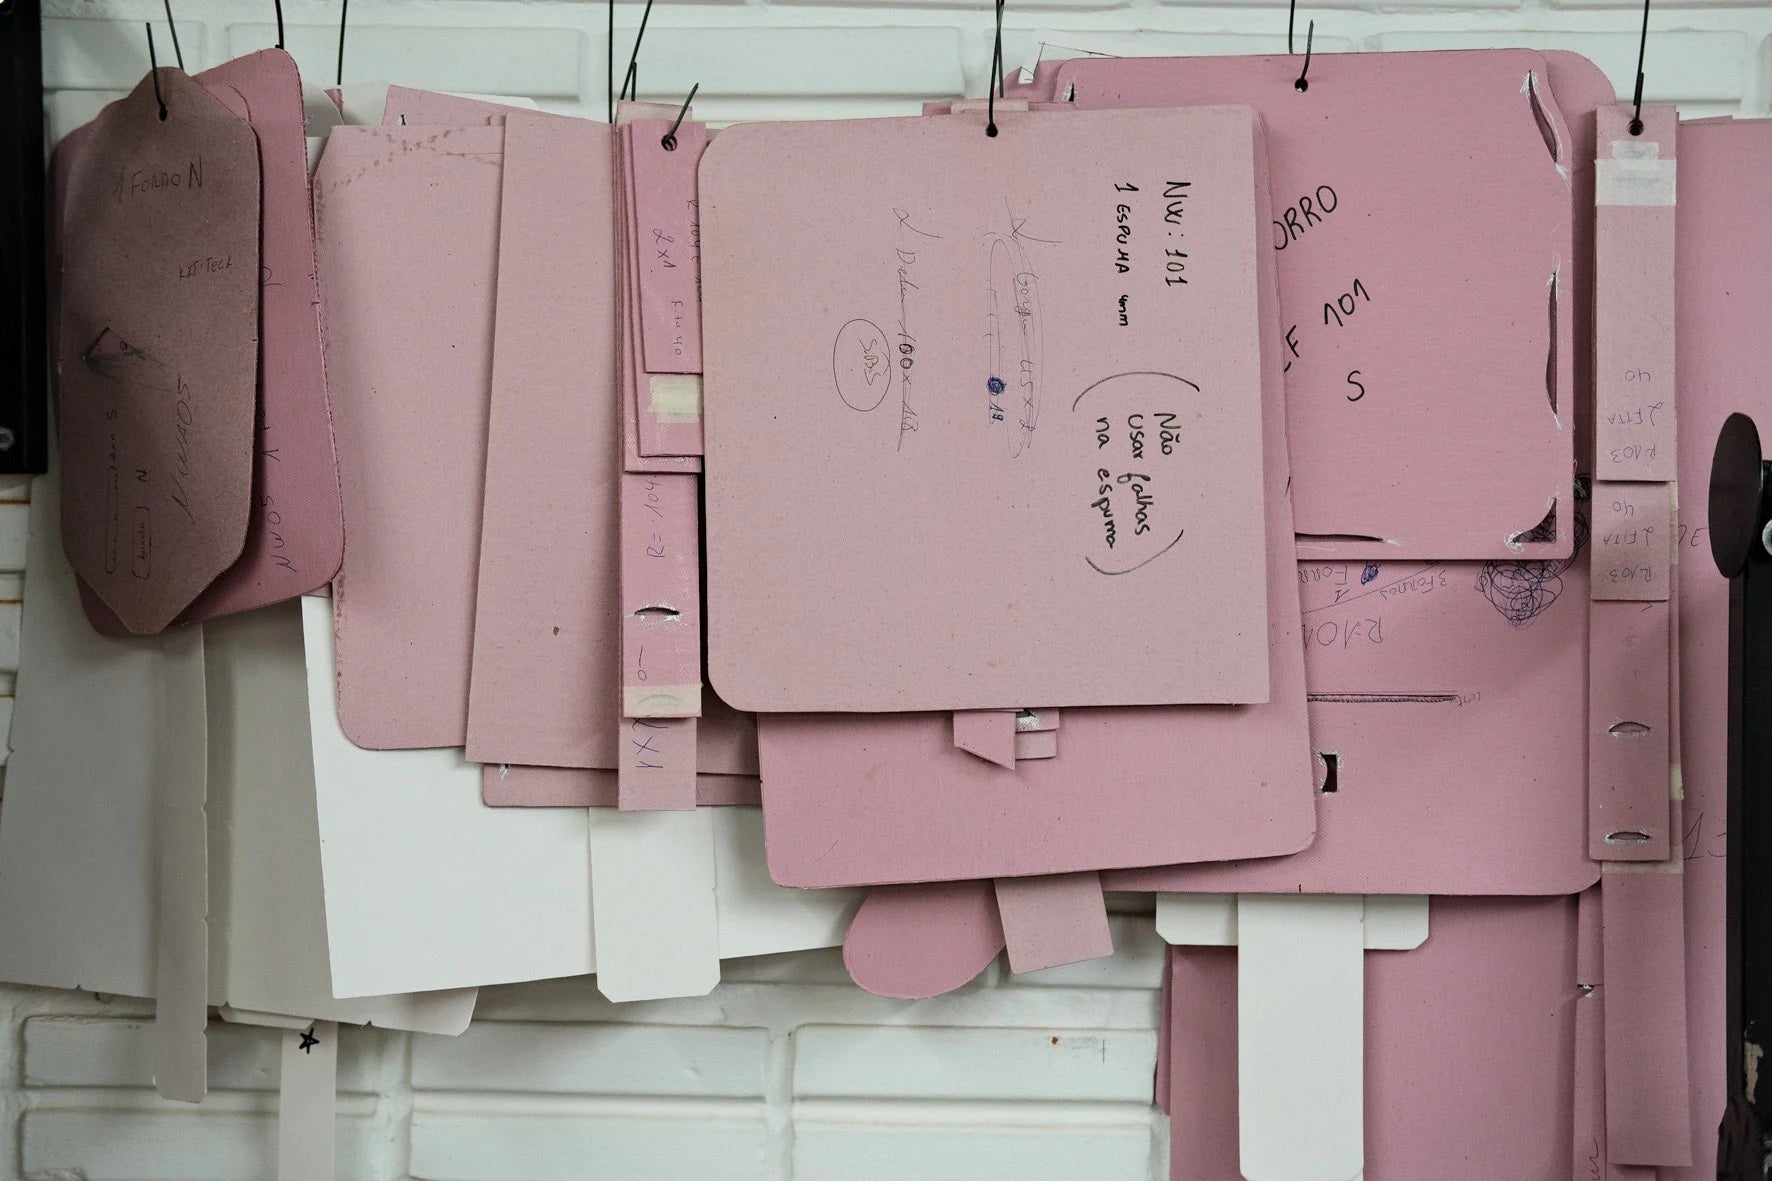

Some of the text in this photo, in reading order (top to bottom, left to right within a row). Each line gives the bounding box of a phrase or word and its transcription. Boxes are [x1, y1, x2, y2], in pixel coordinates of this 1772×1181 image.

[1114, 183, 1139, 193] 1
[1114, 204, 1132, 274] ESPUMA
[1272, 185, 1338, 250] ORRO
[1165, 249, 1187, 287] 101
[1323, 278, 1371, 327] 101
[1346, 369, 1365, 402] S
[1154, 412, 1182, 456] Não
[1091, 417, 1118, 550] na espuma
[1117, 472, 1151, 537] falhas
